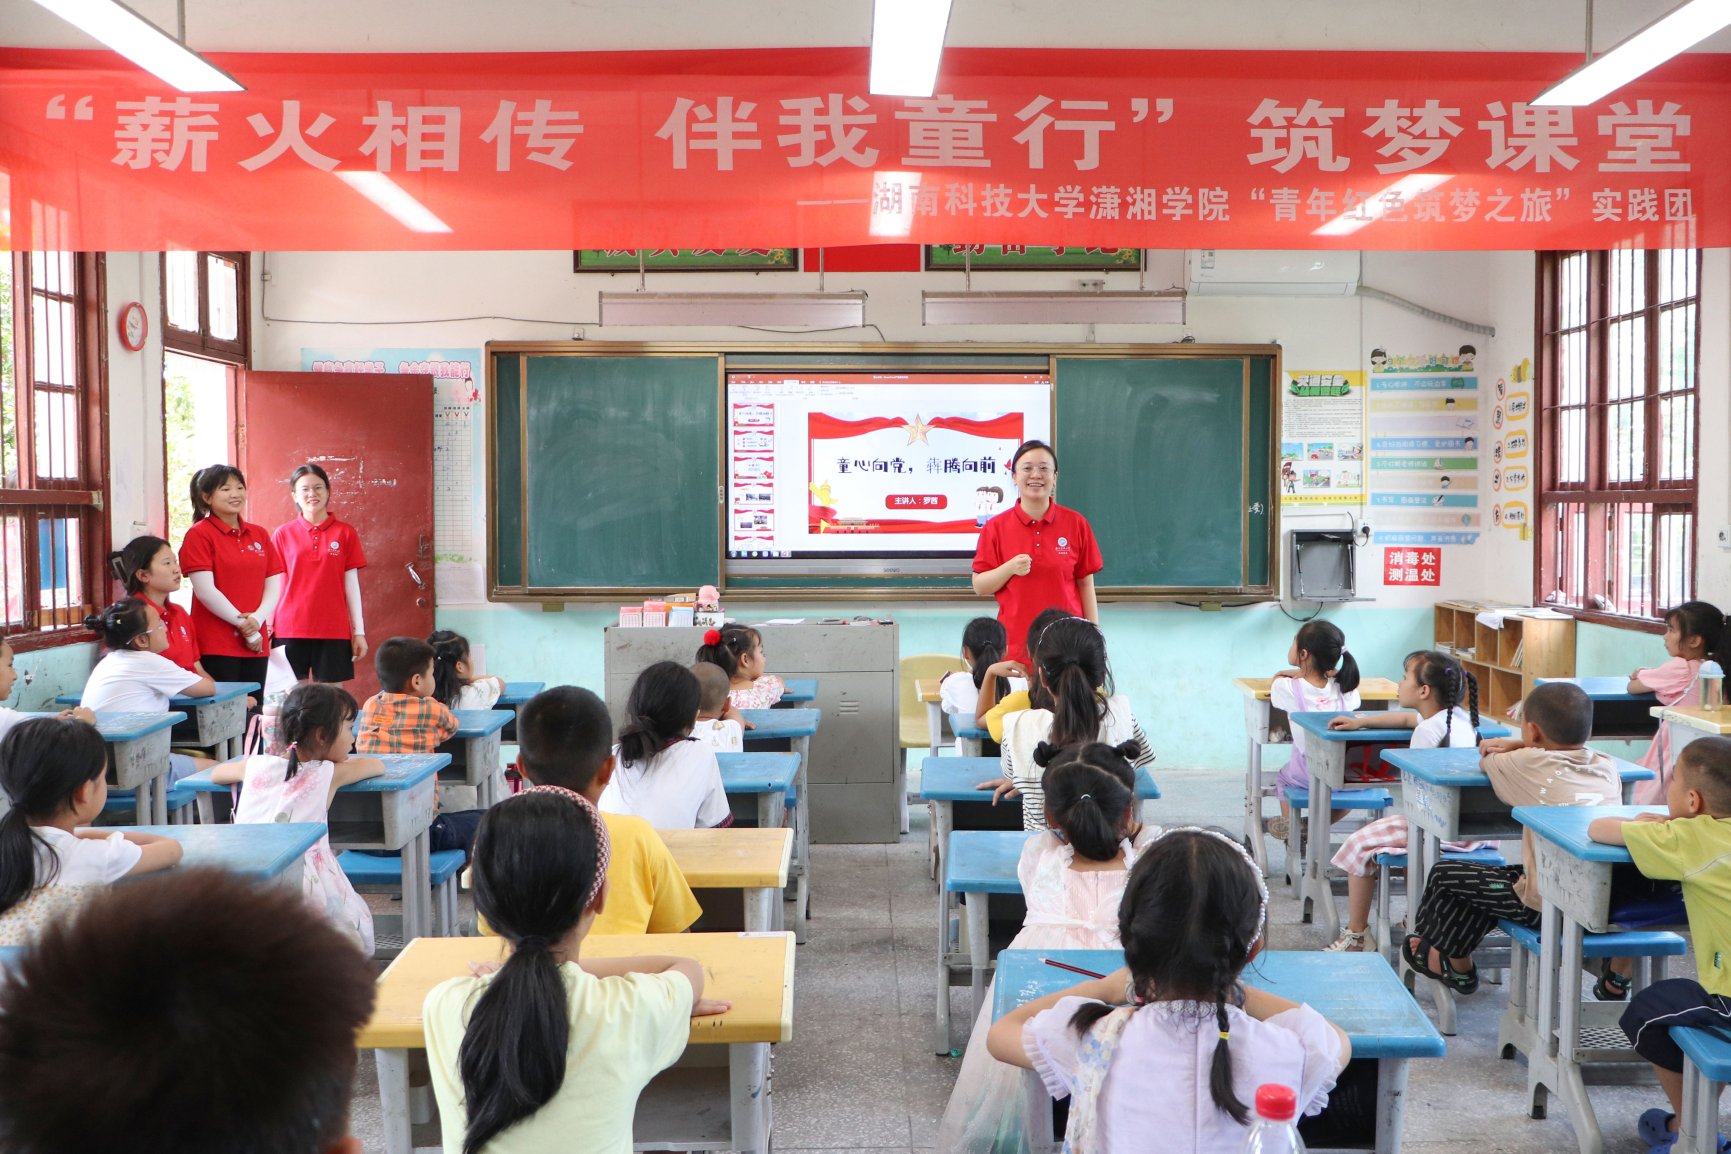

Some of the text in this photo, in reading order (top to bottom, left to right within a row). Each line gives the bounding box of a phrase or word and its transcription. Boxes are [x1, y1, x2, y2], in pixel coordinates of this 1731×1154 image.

[45, 93, 1692, 175] “薪火相传 伴我童行” 筑梦课堂
[1591, 187, 1696, 223] 实践团
[836, 457, 914, 474] 童心向党，
[1389, 551, 1436, 566] 消毒处
[1388, 568, 1436, 582] 测温处
